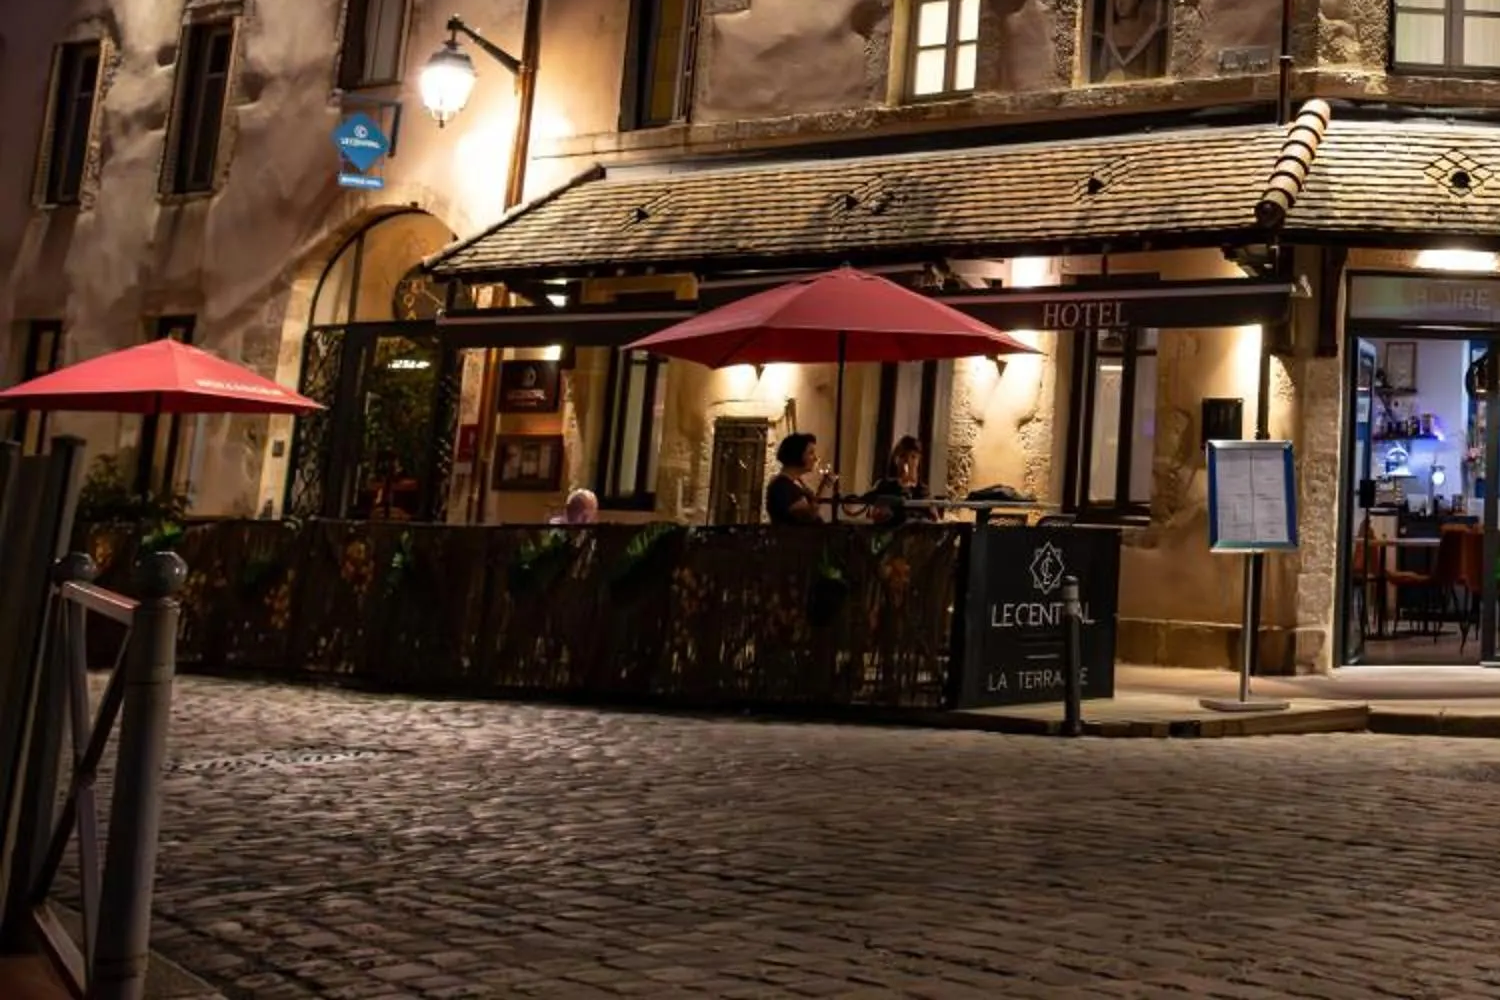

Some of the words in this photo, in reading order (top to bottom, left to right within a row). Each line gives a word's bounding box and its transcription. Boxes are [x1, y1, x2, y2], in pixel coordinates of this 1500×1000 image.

[1043, 302, 1129, 327] HOTEL
[991, 602, 1096, 627] LECENTAL
[987, 671, 1008, 691] LA
[1017, 667, 1089, 690] TERRAE
